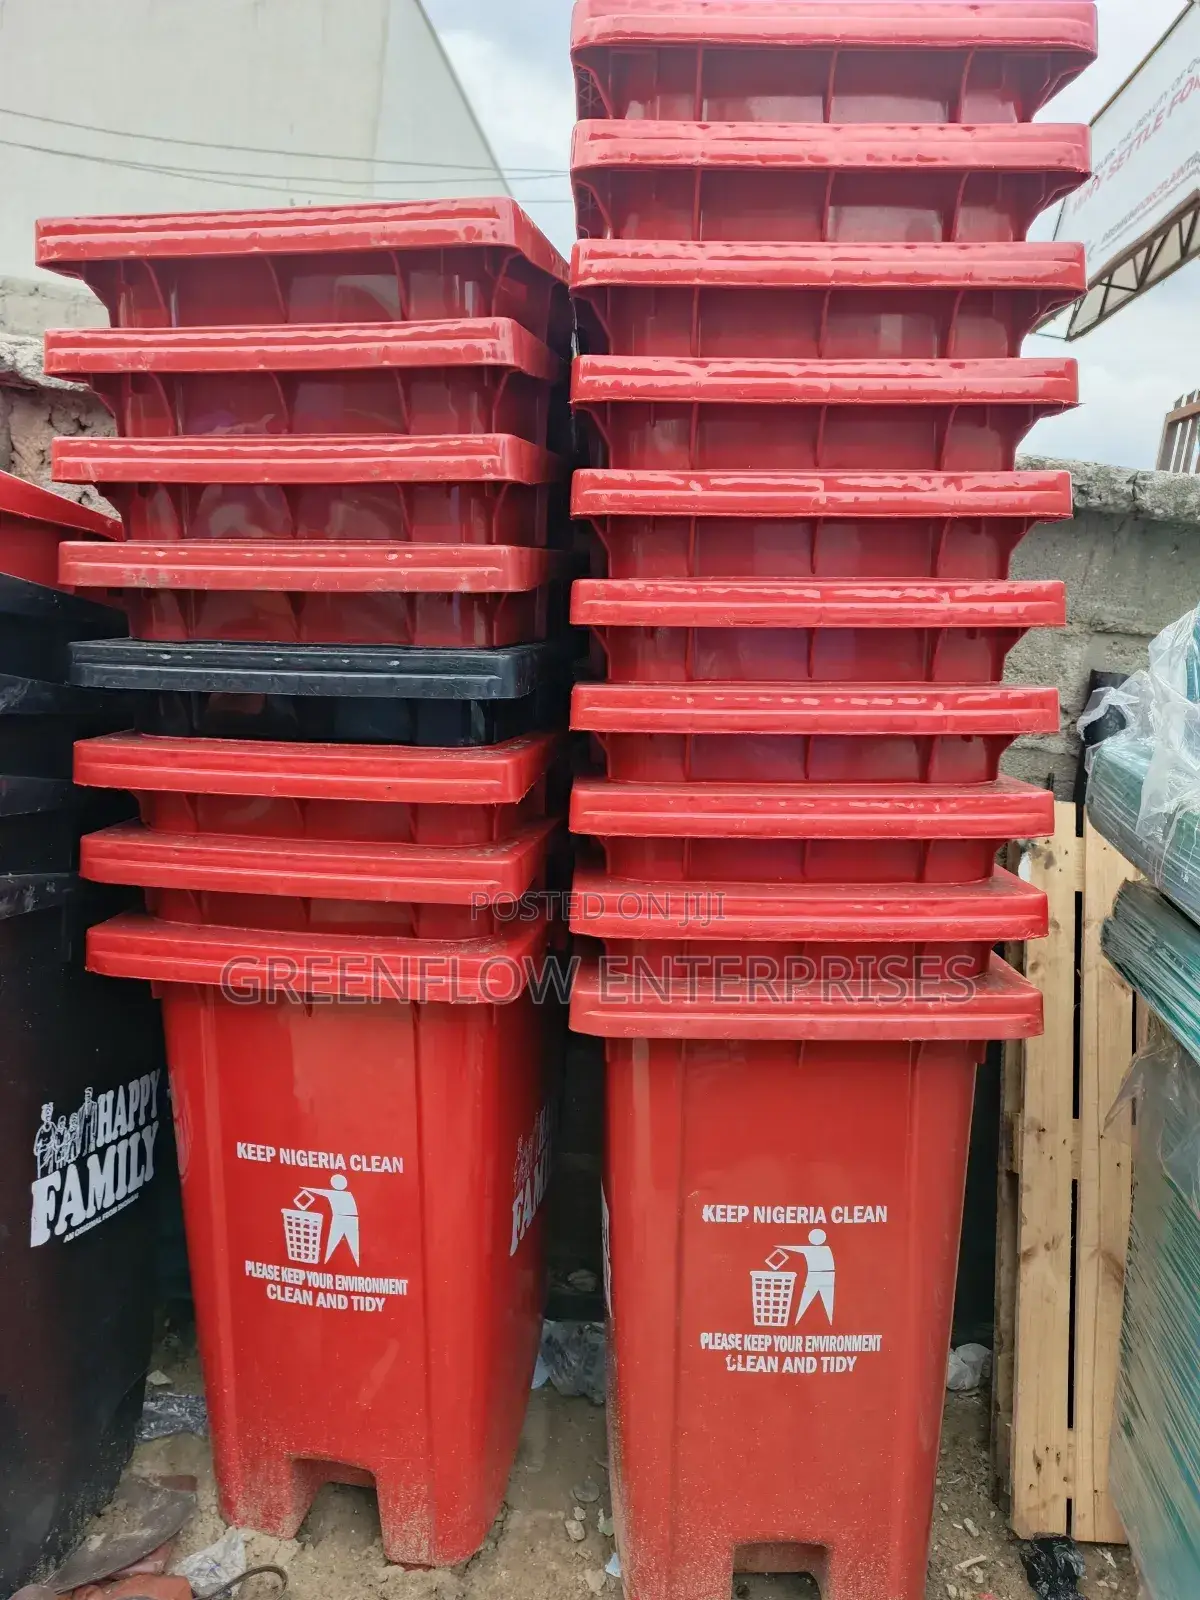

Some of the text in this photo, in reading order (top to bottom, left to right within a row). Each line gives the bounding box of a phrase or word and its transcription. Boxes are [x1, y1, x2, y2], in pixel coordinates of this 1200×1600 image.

[1107, 106, 1166, 181] SETTLE
[97, 1068, 160, 1147] HAPPY
[236, 1141, 404, 1173] KEEP NIGERIA CLEAN
[30, 1121, 159, 1248] FAMILY
[702, 1205, 888, 1224] KEEP NIGERIA CLEAN
[245, 1260, 408, 1296] PLEASE KEEP YOUR ENVIRONMENT
[266, 1283, 386, 1312] CLEAN AND TIDY
[700, 1332, 882, 1353] PLEASE KEEP YOUR ENVIRONMENT
[725, 1354, 857, 1374] CLEAN AND TIDY
